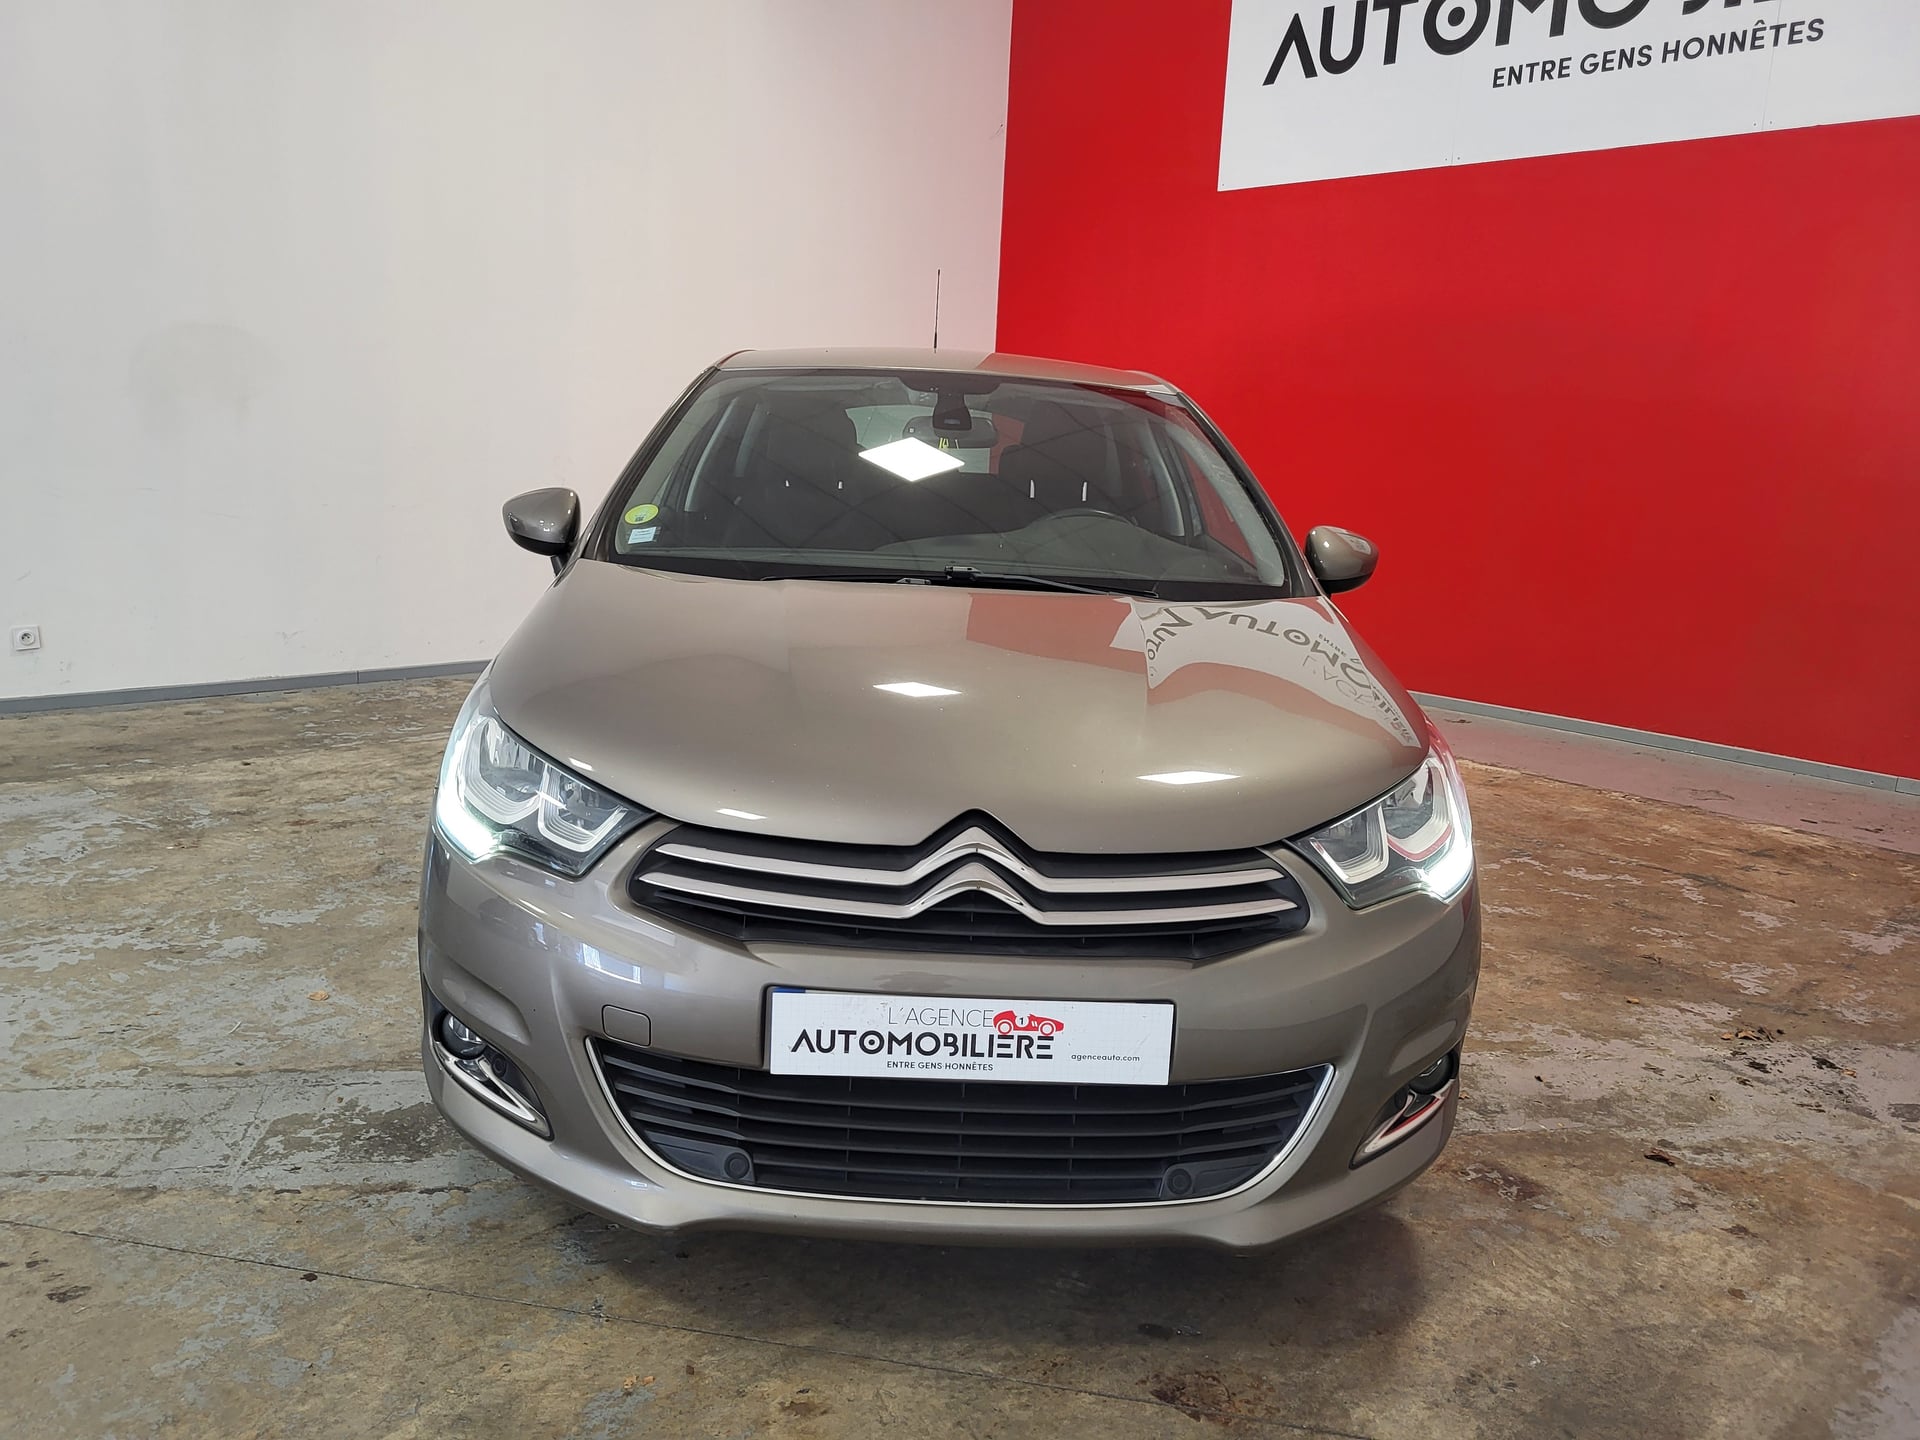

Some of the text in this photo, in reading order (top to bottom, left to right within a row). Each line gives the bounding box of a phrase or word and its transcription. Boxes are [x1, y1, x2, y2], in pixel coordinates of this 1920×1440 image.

[1492, 17, 1825, 89] ENTRE GENS HONNÊTES
[1071, 1053, 1140, 1062] agenceauto.com
[886, 1060, 994, 1071] ENTRE GENS HONNÊTES
